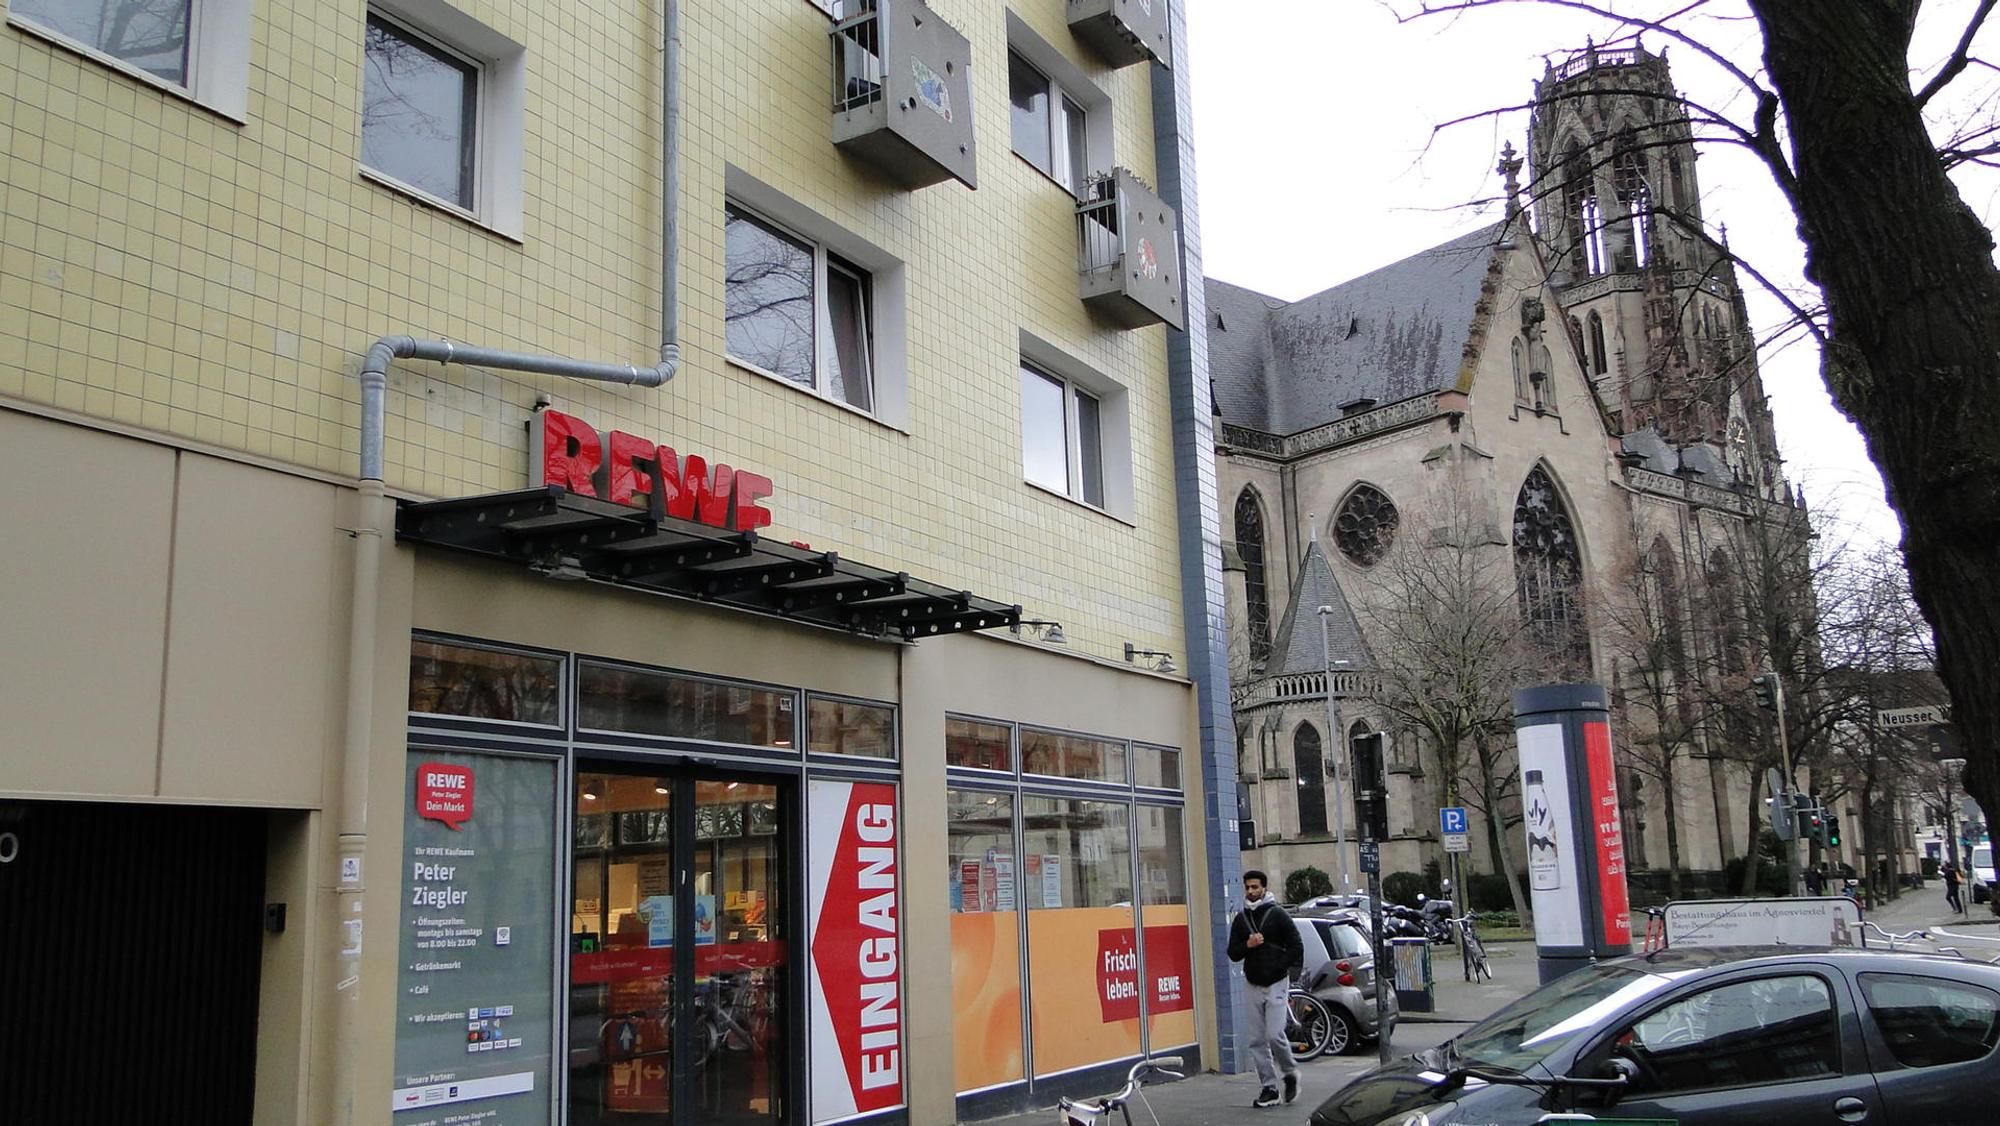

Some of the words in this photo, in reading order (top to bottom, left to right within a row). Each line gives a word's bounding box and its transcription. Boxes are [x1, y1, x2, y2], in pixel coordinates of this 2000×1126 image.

[543, 409, 774, 532] REWE
[1882, 712, 1932, 725] Neusser
[426, 772, 466, 789] REWE
[445, 791, 462, 799] Ziegler
[426, 800, 442, 811] Dein
[443, 801, 465, 812] Markt
[1528, 798, 1547, 827] vly
[1447, 811, 1459, 830] P
[426, 847, 443, 856] REWE
[445, 847, 475, 856] Kaufmann
[414, 862, 456, 881] Peter
[412, 886, 468, 909] Ziegler
[445, 928, 455, 936] bis
[447, 939, 457, 947] bis
[857, 803, 900, 1091] EINGANG
[415, 961, 461, 971] Getränkemarkt
[1105, 947, 1136, 973] Frisch
[415, 985, 429, 994] Café
[1106, 977, 1138, 1000] leben.
[1158, 975, 1180, 993] REWE
[414, 1014, 425, 1022] Wir
